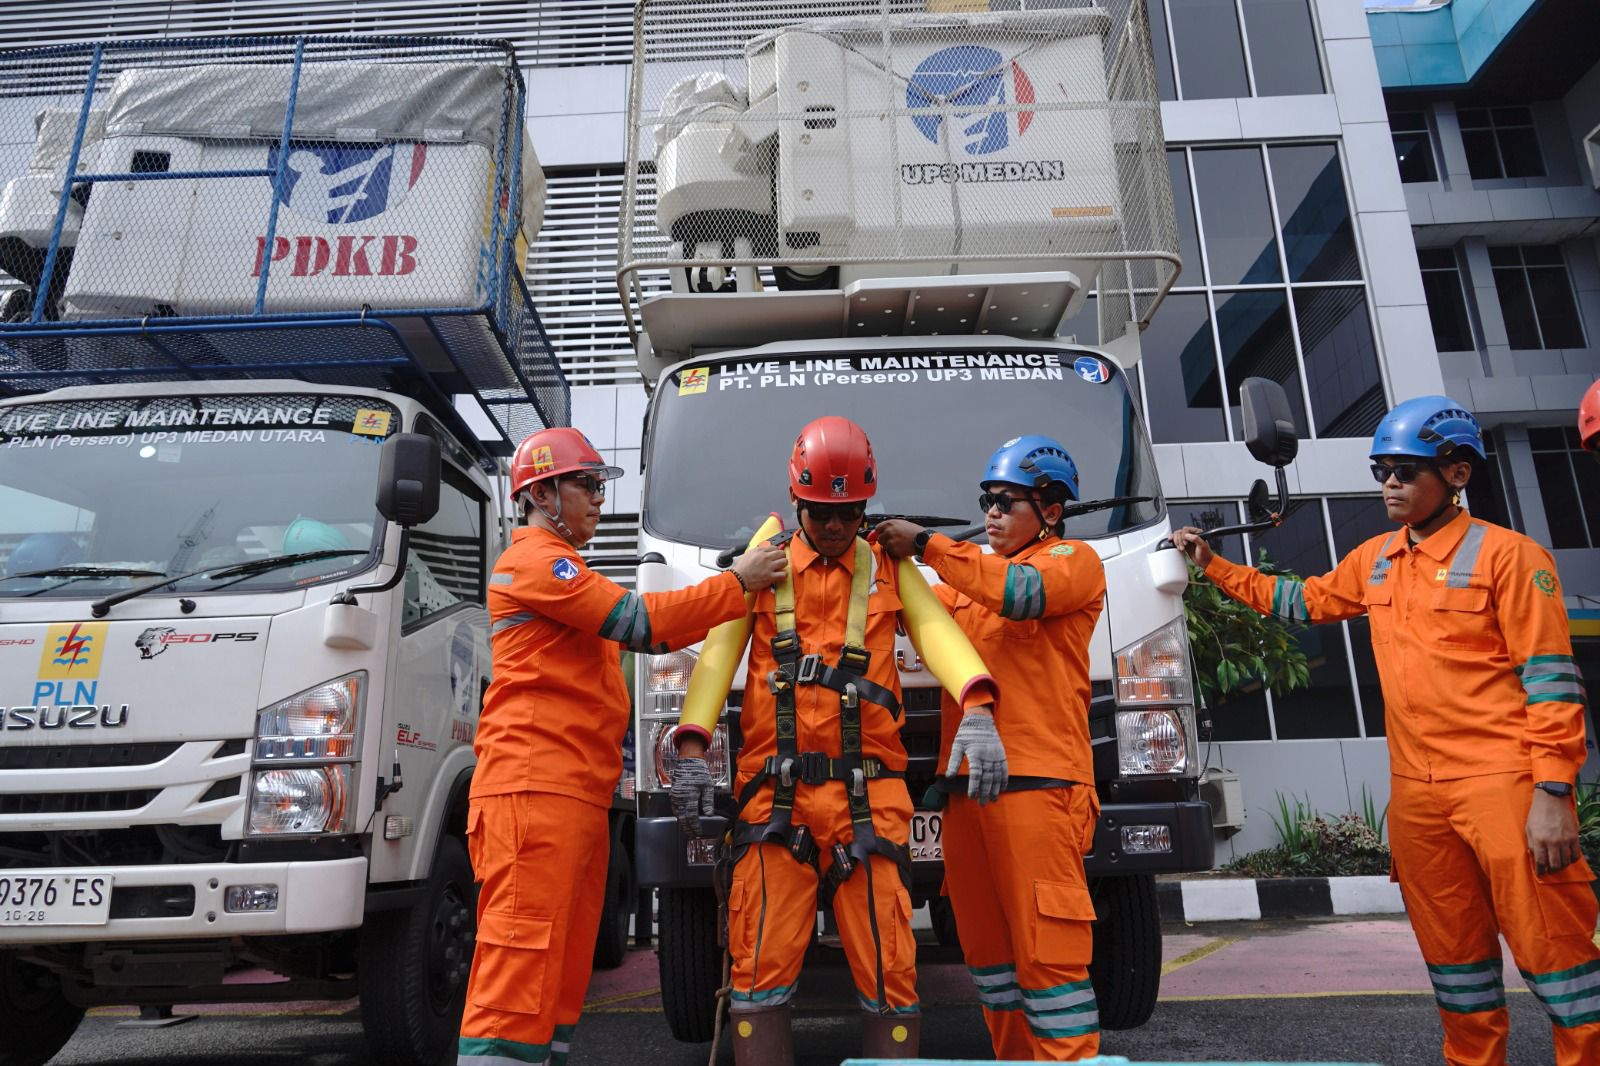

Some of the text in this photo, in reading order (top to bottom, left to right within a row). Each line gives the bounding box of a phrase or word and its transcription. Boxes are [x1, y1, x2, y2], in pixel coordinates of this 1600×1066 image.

[901, 160, 1065, 184] UP3 MEDAN
[251, 235, 418, 277] PDKB
[719, 354, 1061, 377] LIVE LINE MAINTENANCE
[719, 367, 1063, 391] PT. PLN (Persero) UP3 MEDAN
[0, 407, 332, 432] IVE LINE MAINTENANCE
[8, 430, 326, 450] PLN (Persero) UP3 MEDAN UTARA
[32, 681, 97, 706] PLN
[0, 704, 129, 731] ISUZU
[397, 730, 420, 743] ELF
[72, 878, 104, 906] ES
